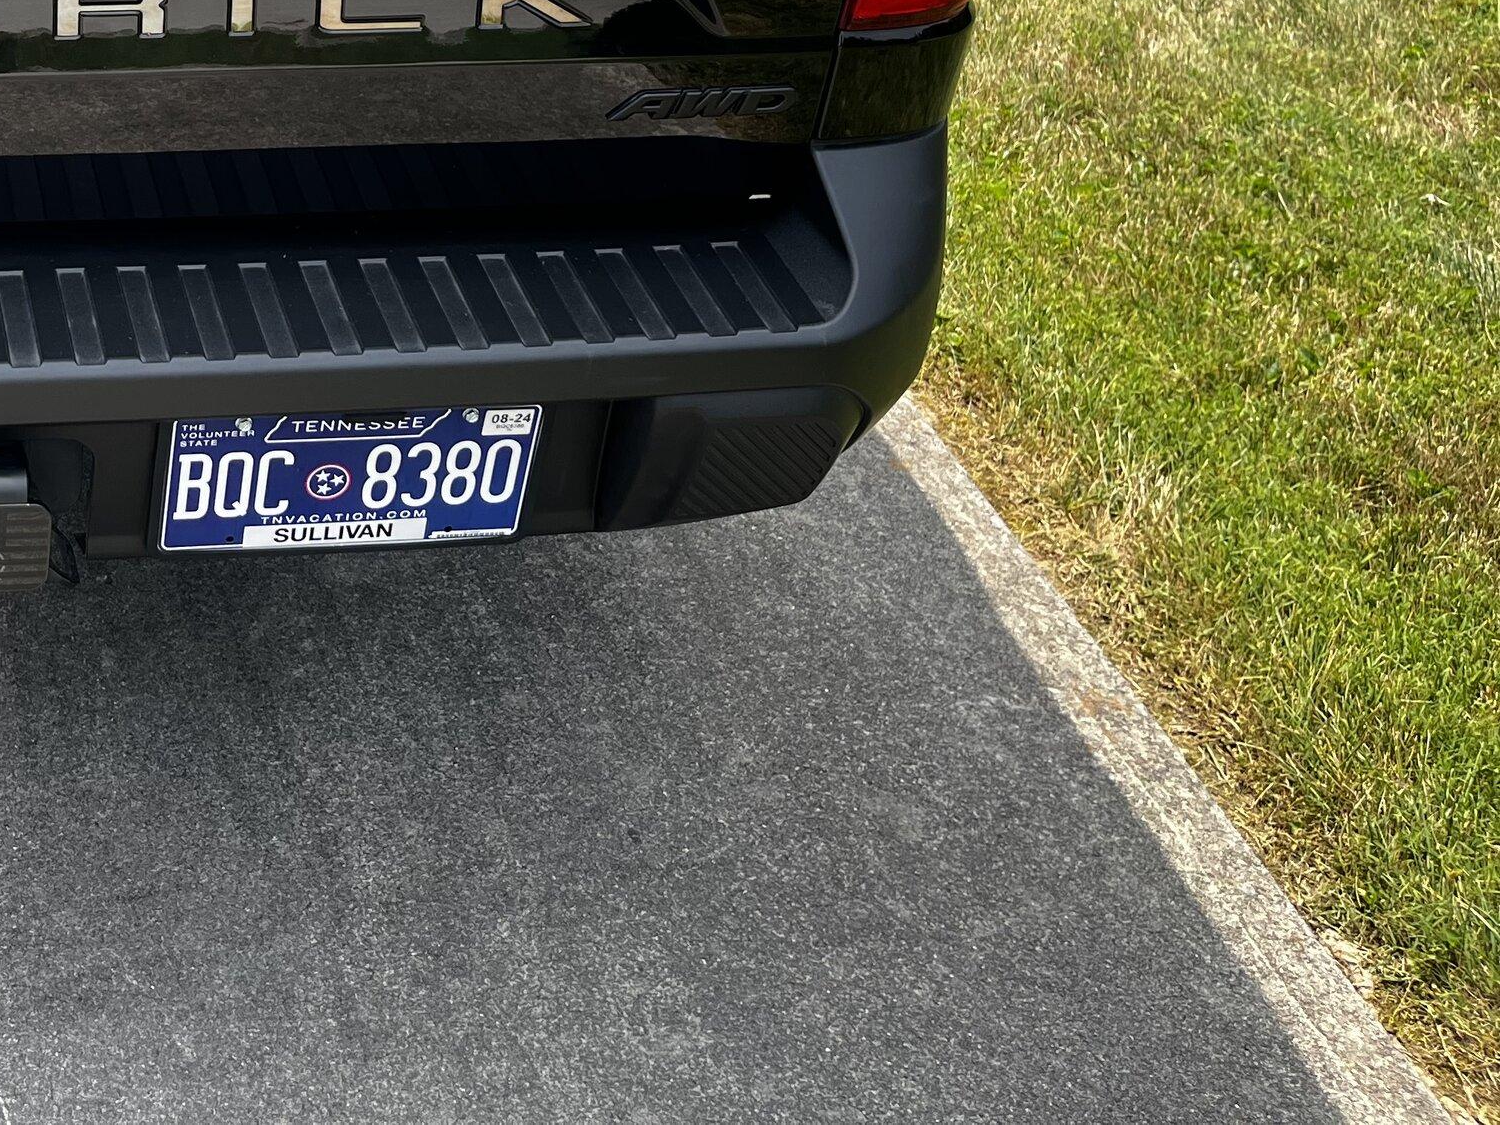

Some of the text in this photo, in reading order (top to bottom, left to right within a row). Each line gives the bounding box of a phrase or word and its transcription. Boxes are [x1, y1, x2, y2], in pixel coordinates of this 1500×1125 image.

[605, 83, 797, 121] AWD
[291, 416, 426, 433] TENNESSEE
[491, 413, 532, 424] 08-24
[180, 429, 255, 440] VOLUNTEER
[181, 423, 206, 431] THE
[180, 439, 218, 448] STATE
[173, 438, 522, 521] BQC 8380
[260, 509, 427, 524] TNVACATION.COM
[273, 523, 393, 543] SULLIVAN
